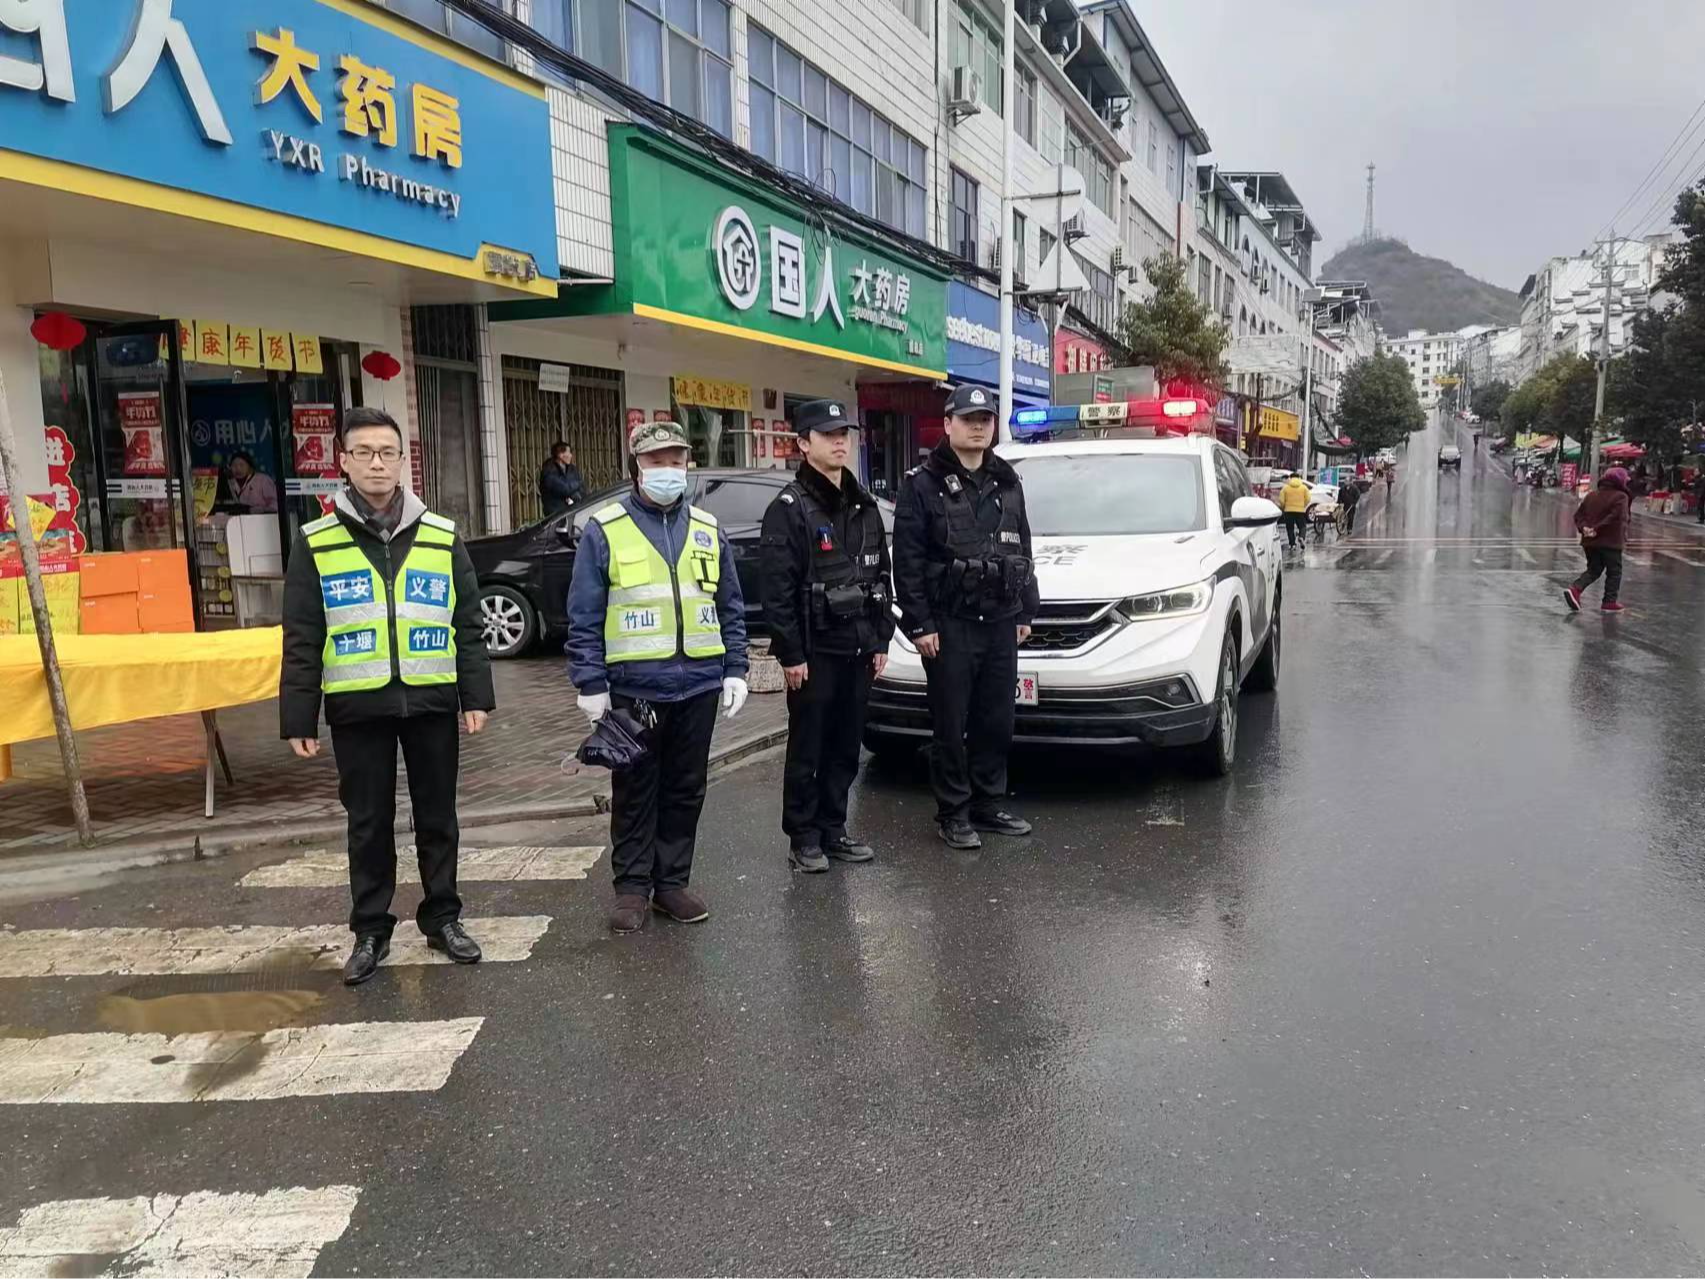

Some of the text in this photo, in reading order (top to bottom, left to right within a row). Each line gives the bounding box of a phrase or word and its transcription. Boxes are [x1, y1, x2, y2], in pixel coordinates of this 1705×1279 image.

[262, 129, 461, 218] YXR Pharmacy
[1087, 405, 1121, 417] 警察
[329, 576, 370, 601] 平安
[410, 577, 447, 601] 义警
[625, 610, 655, 630] 竹山
[413, 629, 446, 649] 竹山
